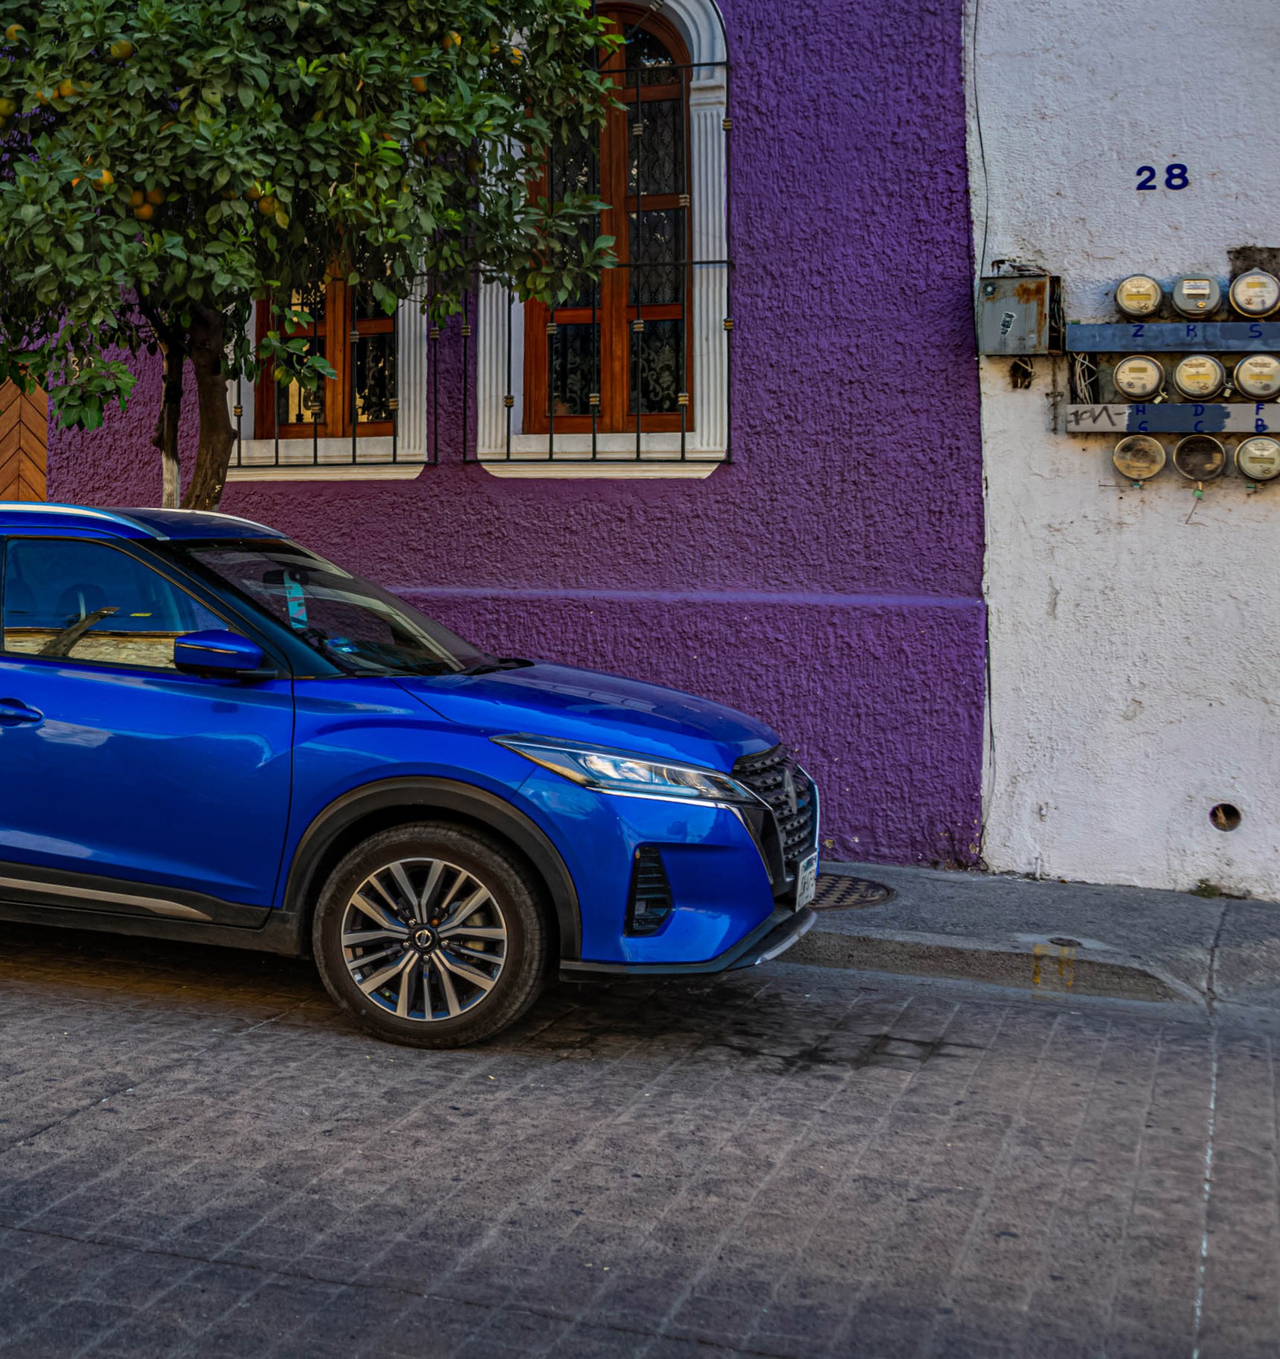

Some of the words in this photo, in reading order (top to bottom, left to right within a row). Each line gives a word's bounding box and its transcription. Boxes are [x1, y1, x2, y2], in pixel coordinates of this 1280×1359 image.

[1136, 163, 1189, 191] 28
[1248, 324, 1263, 339] S
[1135, 404, 1146, 415] H
[1192, 404, 1205, 417] D
[1255, 403, 1265, 415] F
[1194, 420, 1205, 432] C
